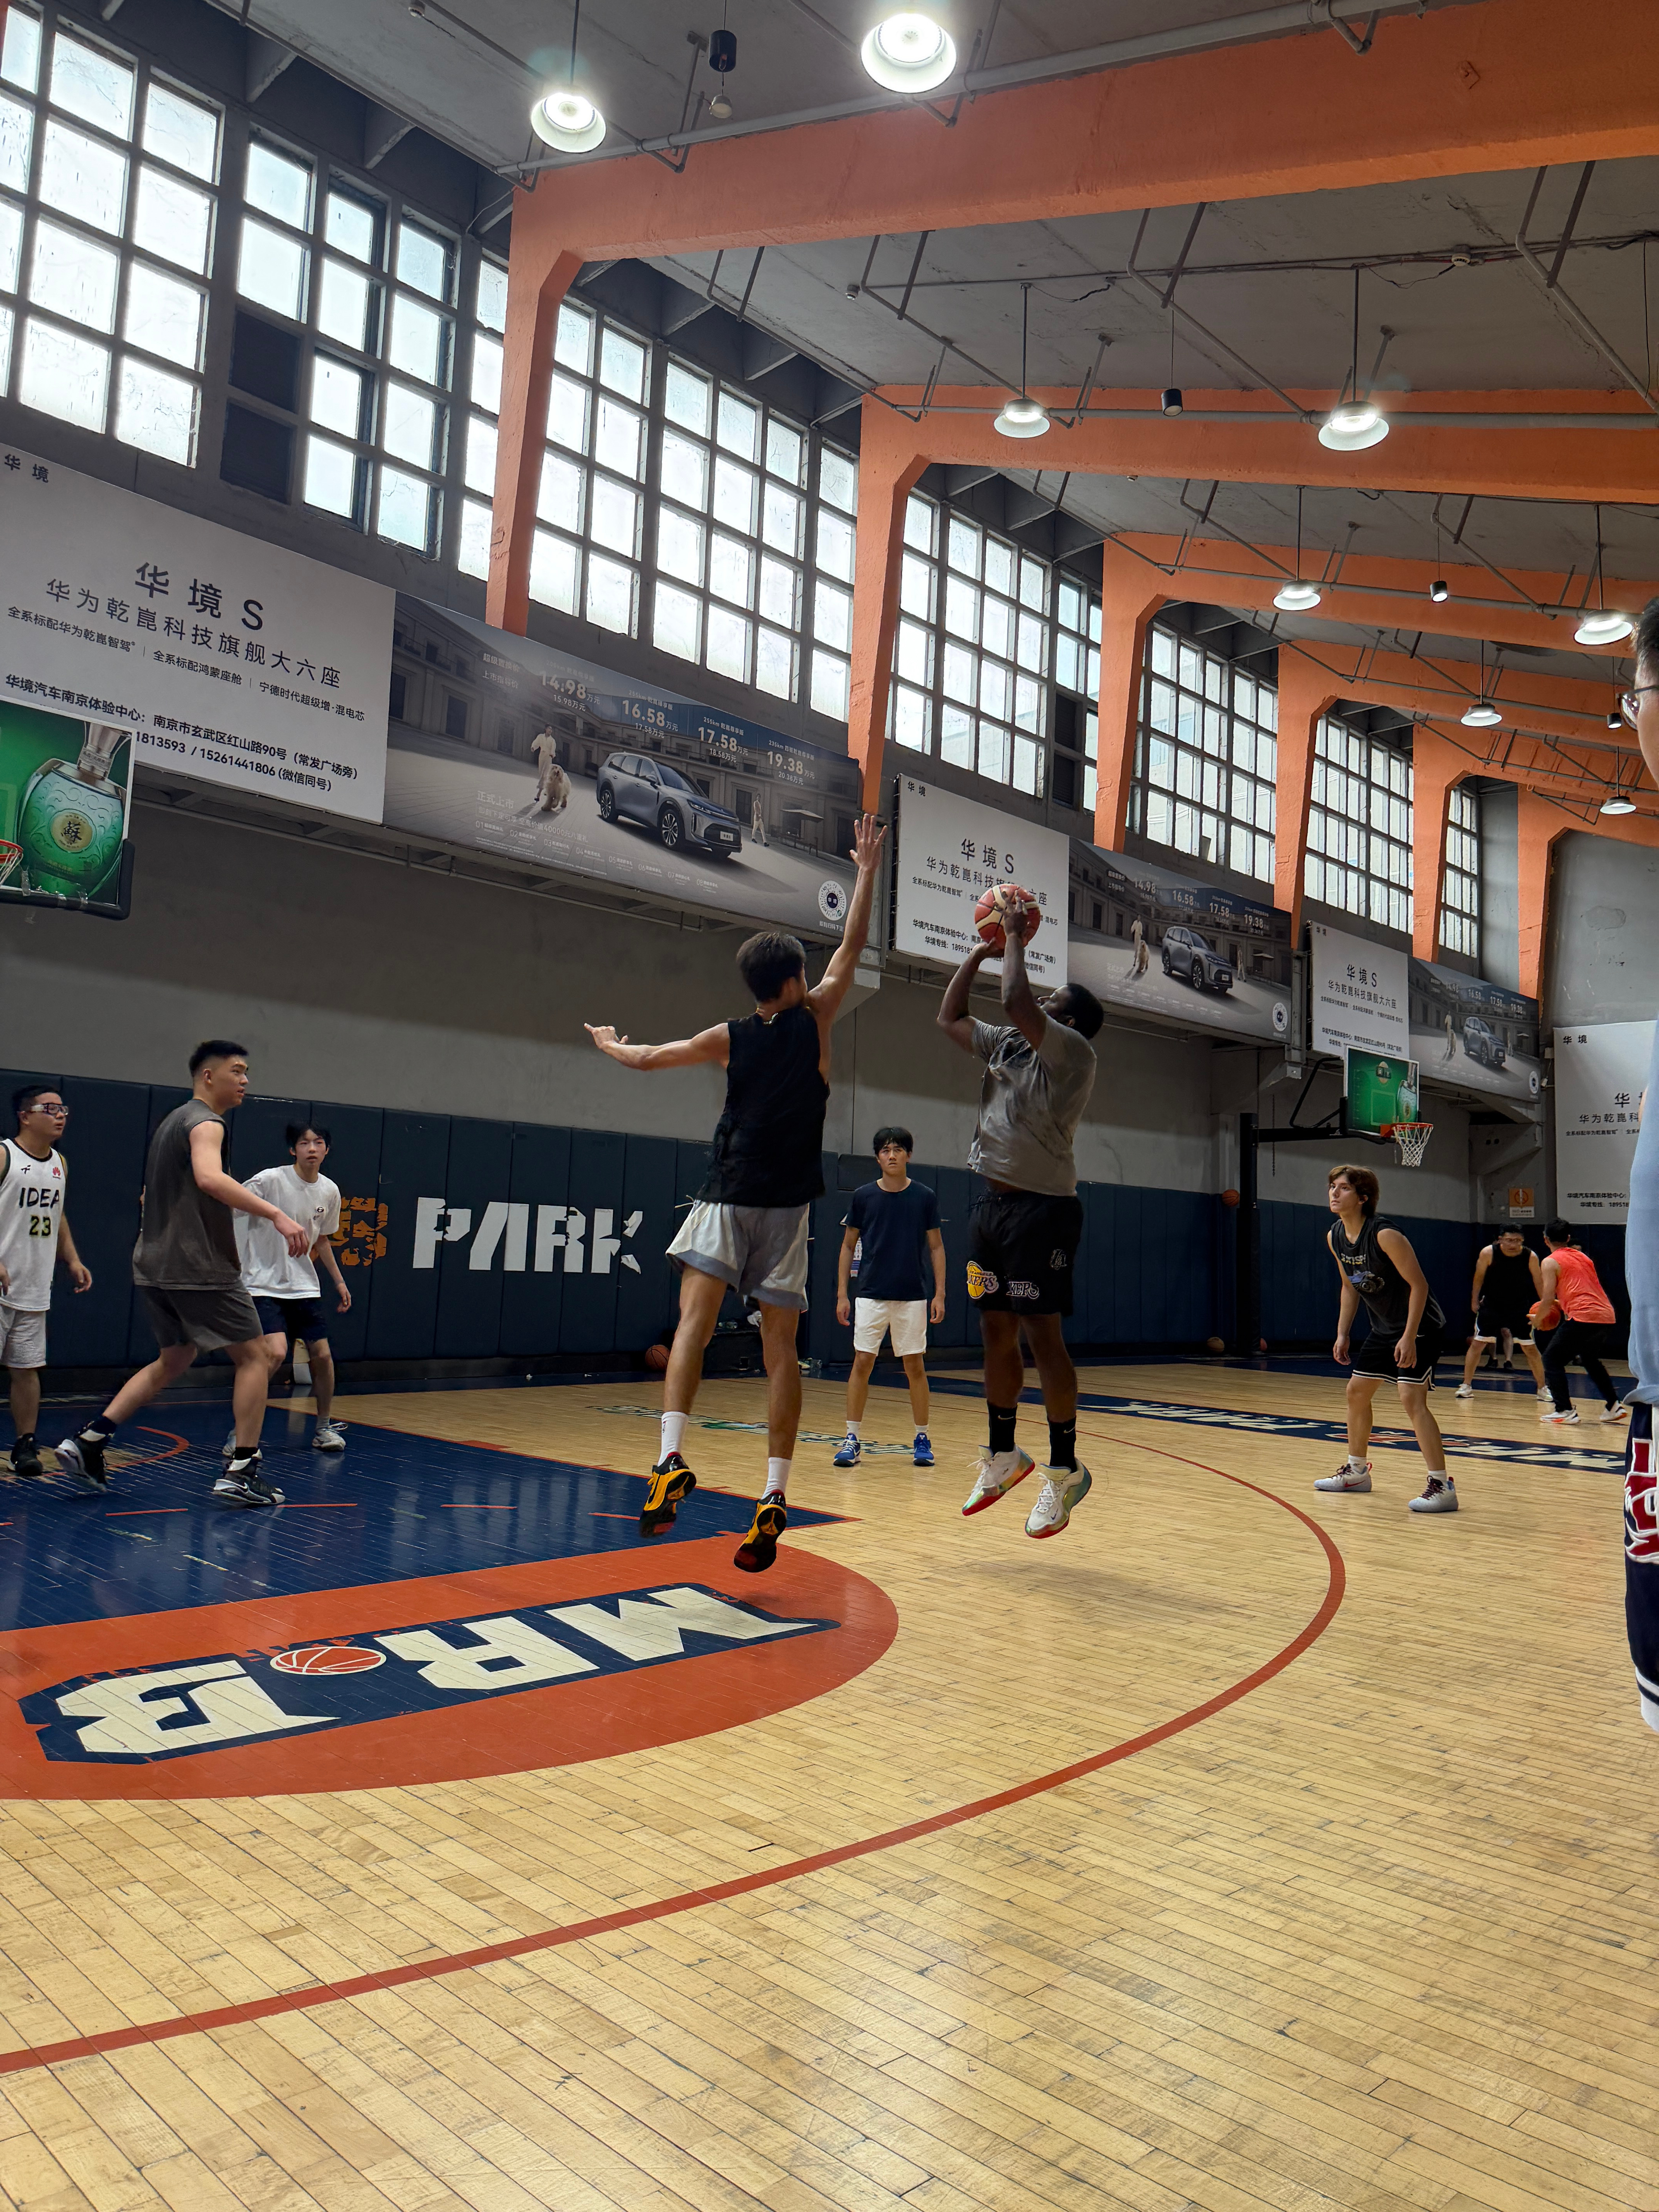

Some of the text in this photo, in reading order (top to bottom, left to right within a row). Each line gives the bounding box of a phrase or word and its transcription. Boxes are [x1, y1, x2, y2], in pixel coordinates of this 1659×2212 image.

[5, 454, 49, 483] 华境
[135, 562, 263, 630] 华境S
[46, 579, 340, 688] 华为乾崑科技旗舰大六座
[153, 650, 242, 685] 全系标配鸿蒙座舱
[554, 695, 586, 712] 15.98万元
[635, 723, 665, 738] 17.58万元
[710, 749, 737, 763] 18.58万元
[779, 771, 804, 785] 20.38万元
[908, 781, 926, 797] 华境
[477, 790, 514, 809] 正式上市
[961, 838, 1014, 874] 华境S
[927, 856, 1047, 905] 华为乾崑科技座
[970, 894, 981, 902] 全系
[1563, 1035, 1587, 1044] 华境
[19, 1187, 60, 1209] IDEA
[29, 1214, 51, 1237] 23
[413, 1197, 644, 1274] PARK
